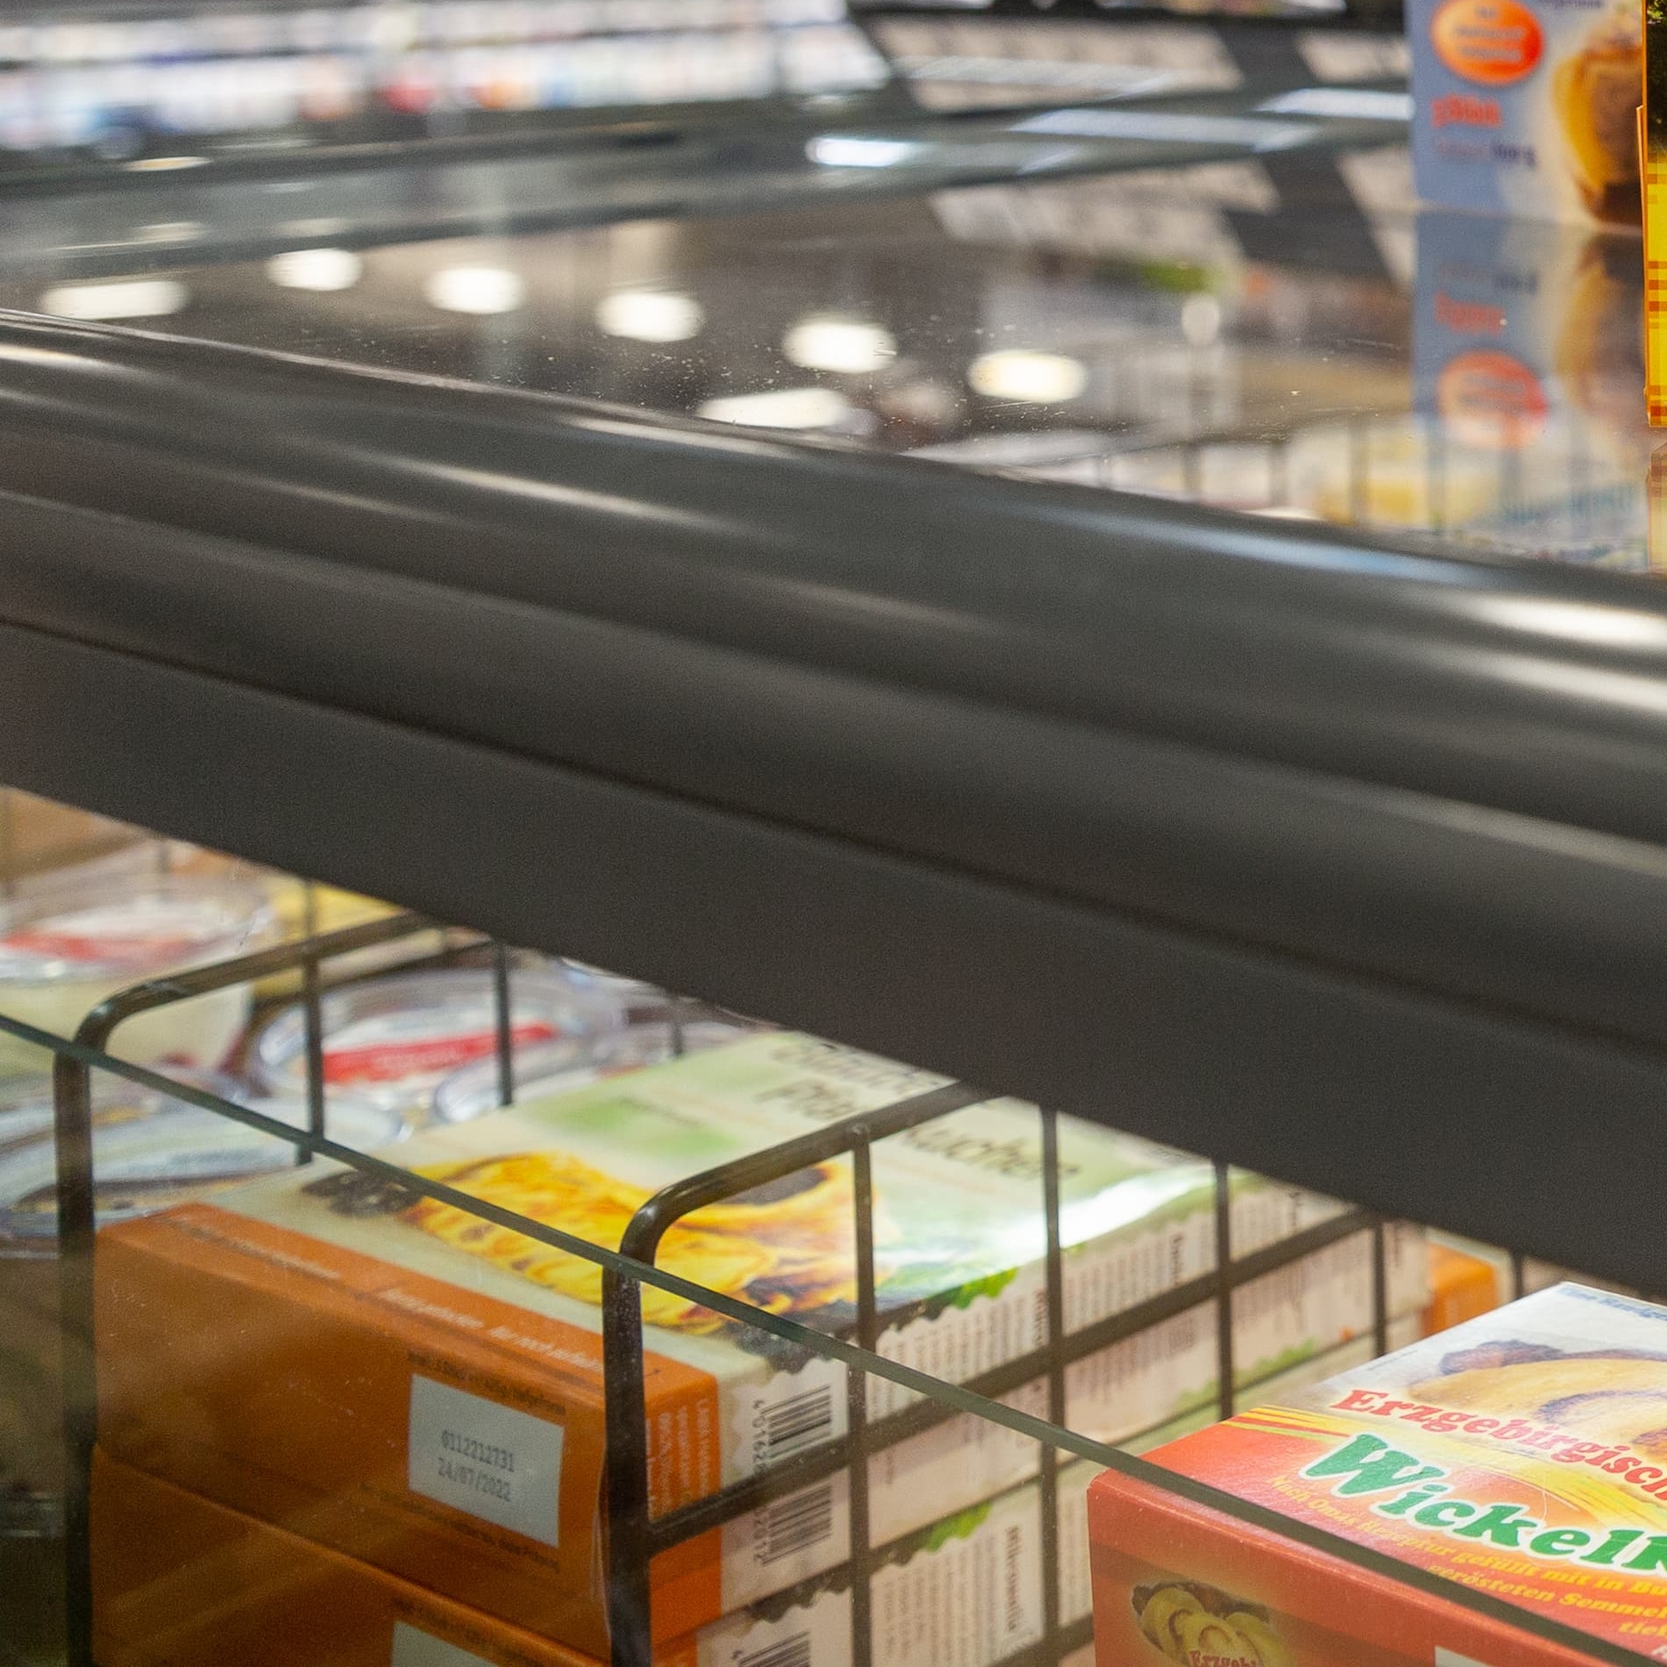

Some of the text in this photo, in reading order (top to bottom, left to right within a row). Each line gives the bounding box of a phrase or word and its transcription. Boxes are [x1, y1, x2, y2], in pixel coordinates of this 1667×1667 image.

[1453, 1550, 1543, 1579] gefüllt
[1540, 1566, 1592, 1586] mit
[1596, 1575, 1623, 1591] in
